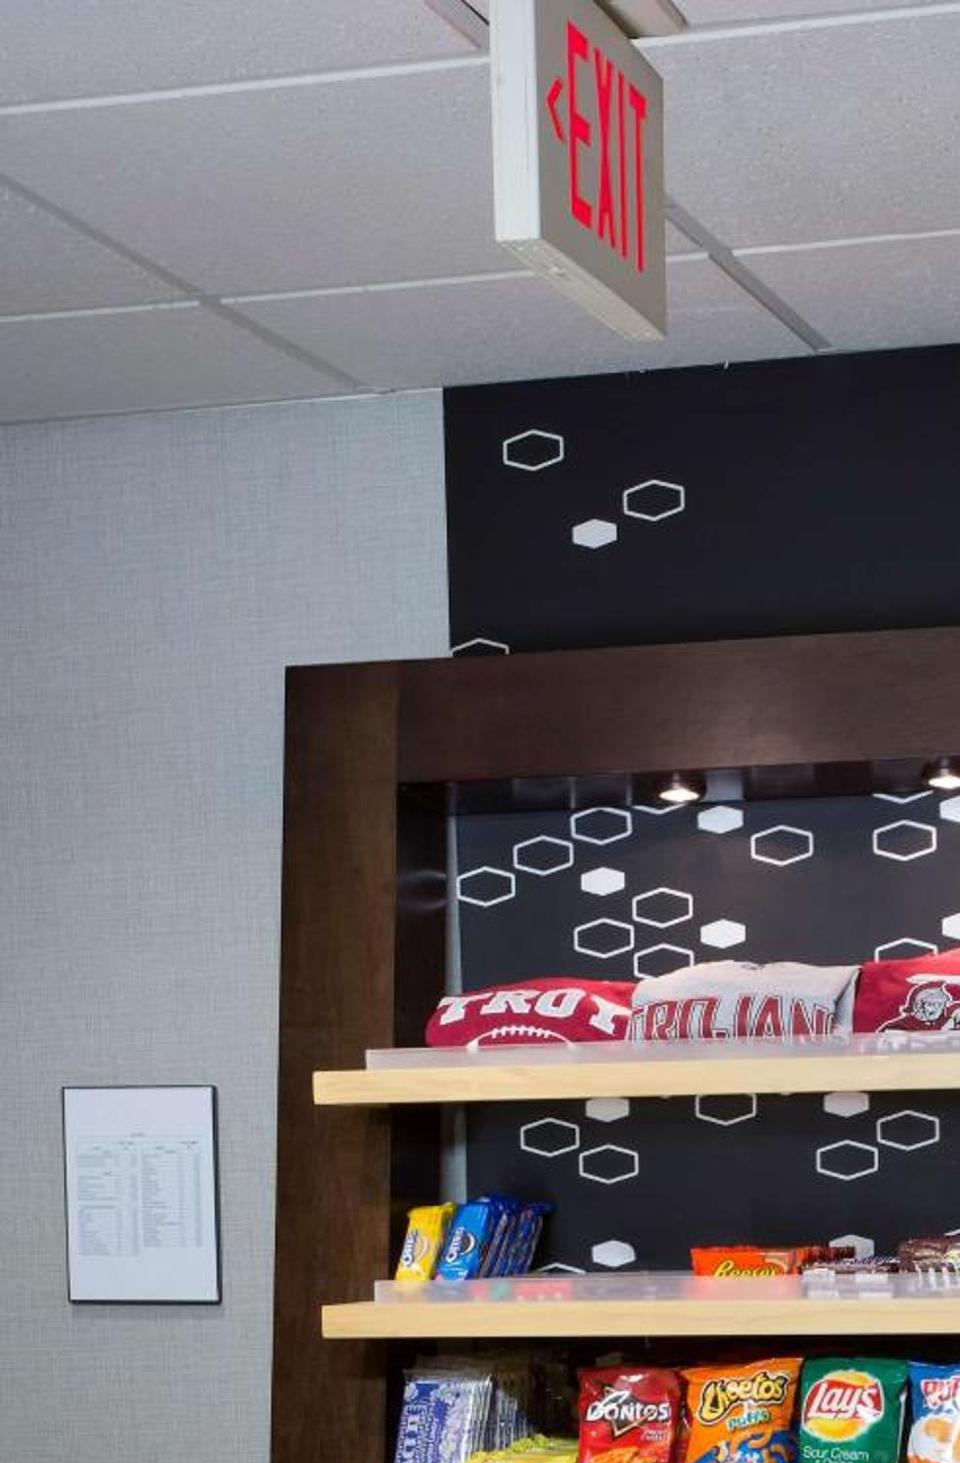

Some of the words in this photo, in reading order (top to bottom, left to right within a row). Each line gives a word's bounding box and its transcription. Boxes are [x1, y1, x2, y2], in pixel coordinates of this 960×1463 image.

[567, 20, 647, 274] EXIT
[438, 988, 632, 1035] TROY
[630, 995, 836, 1042] TROJAN
[699, 1372, 789, 1423] Cheetos
[804, 1446, 828, 1459] Sour
[831, 1448, 869, 1462] Cream
